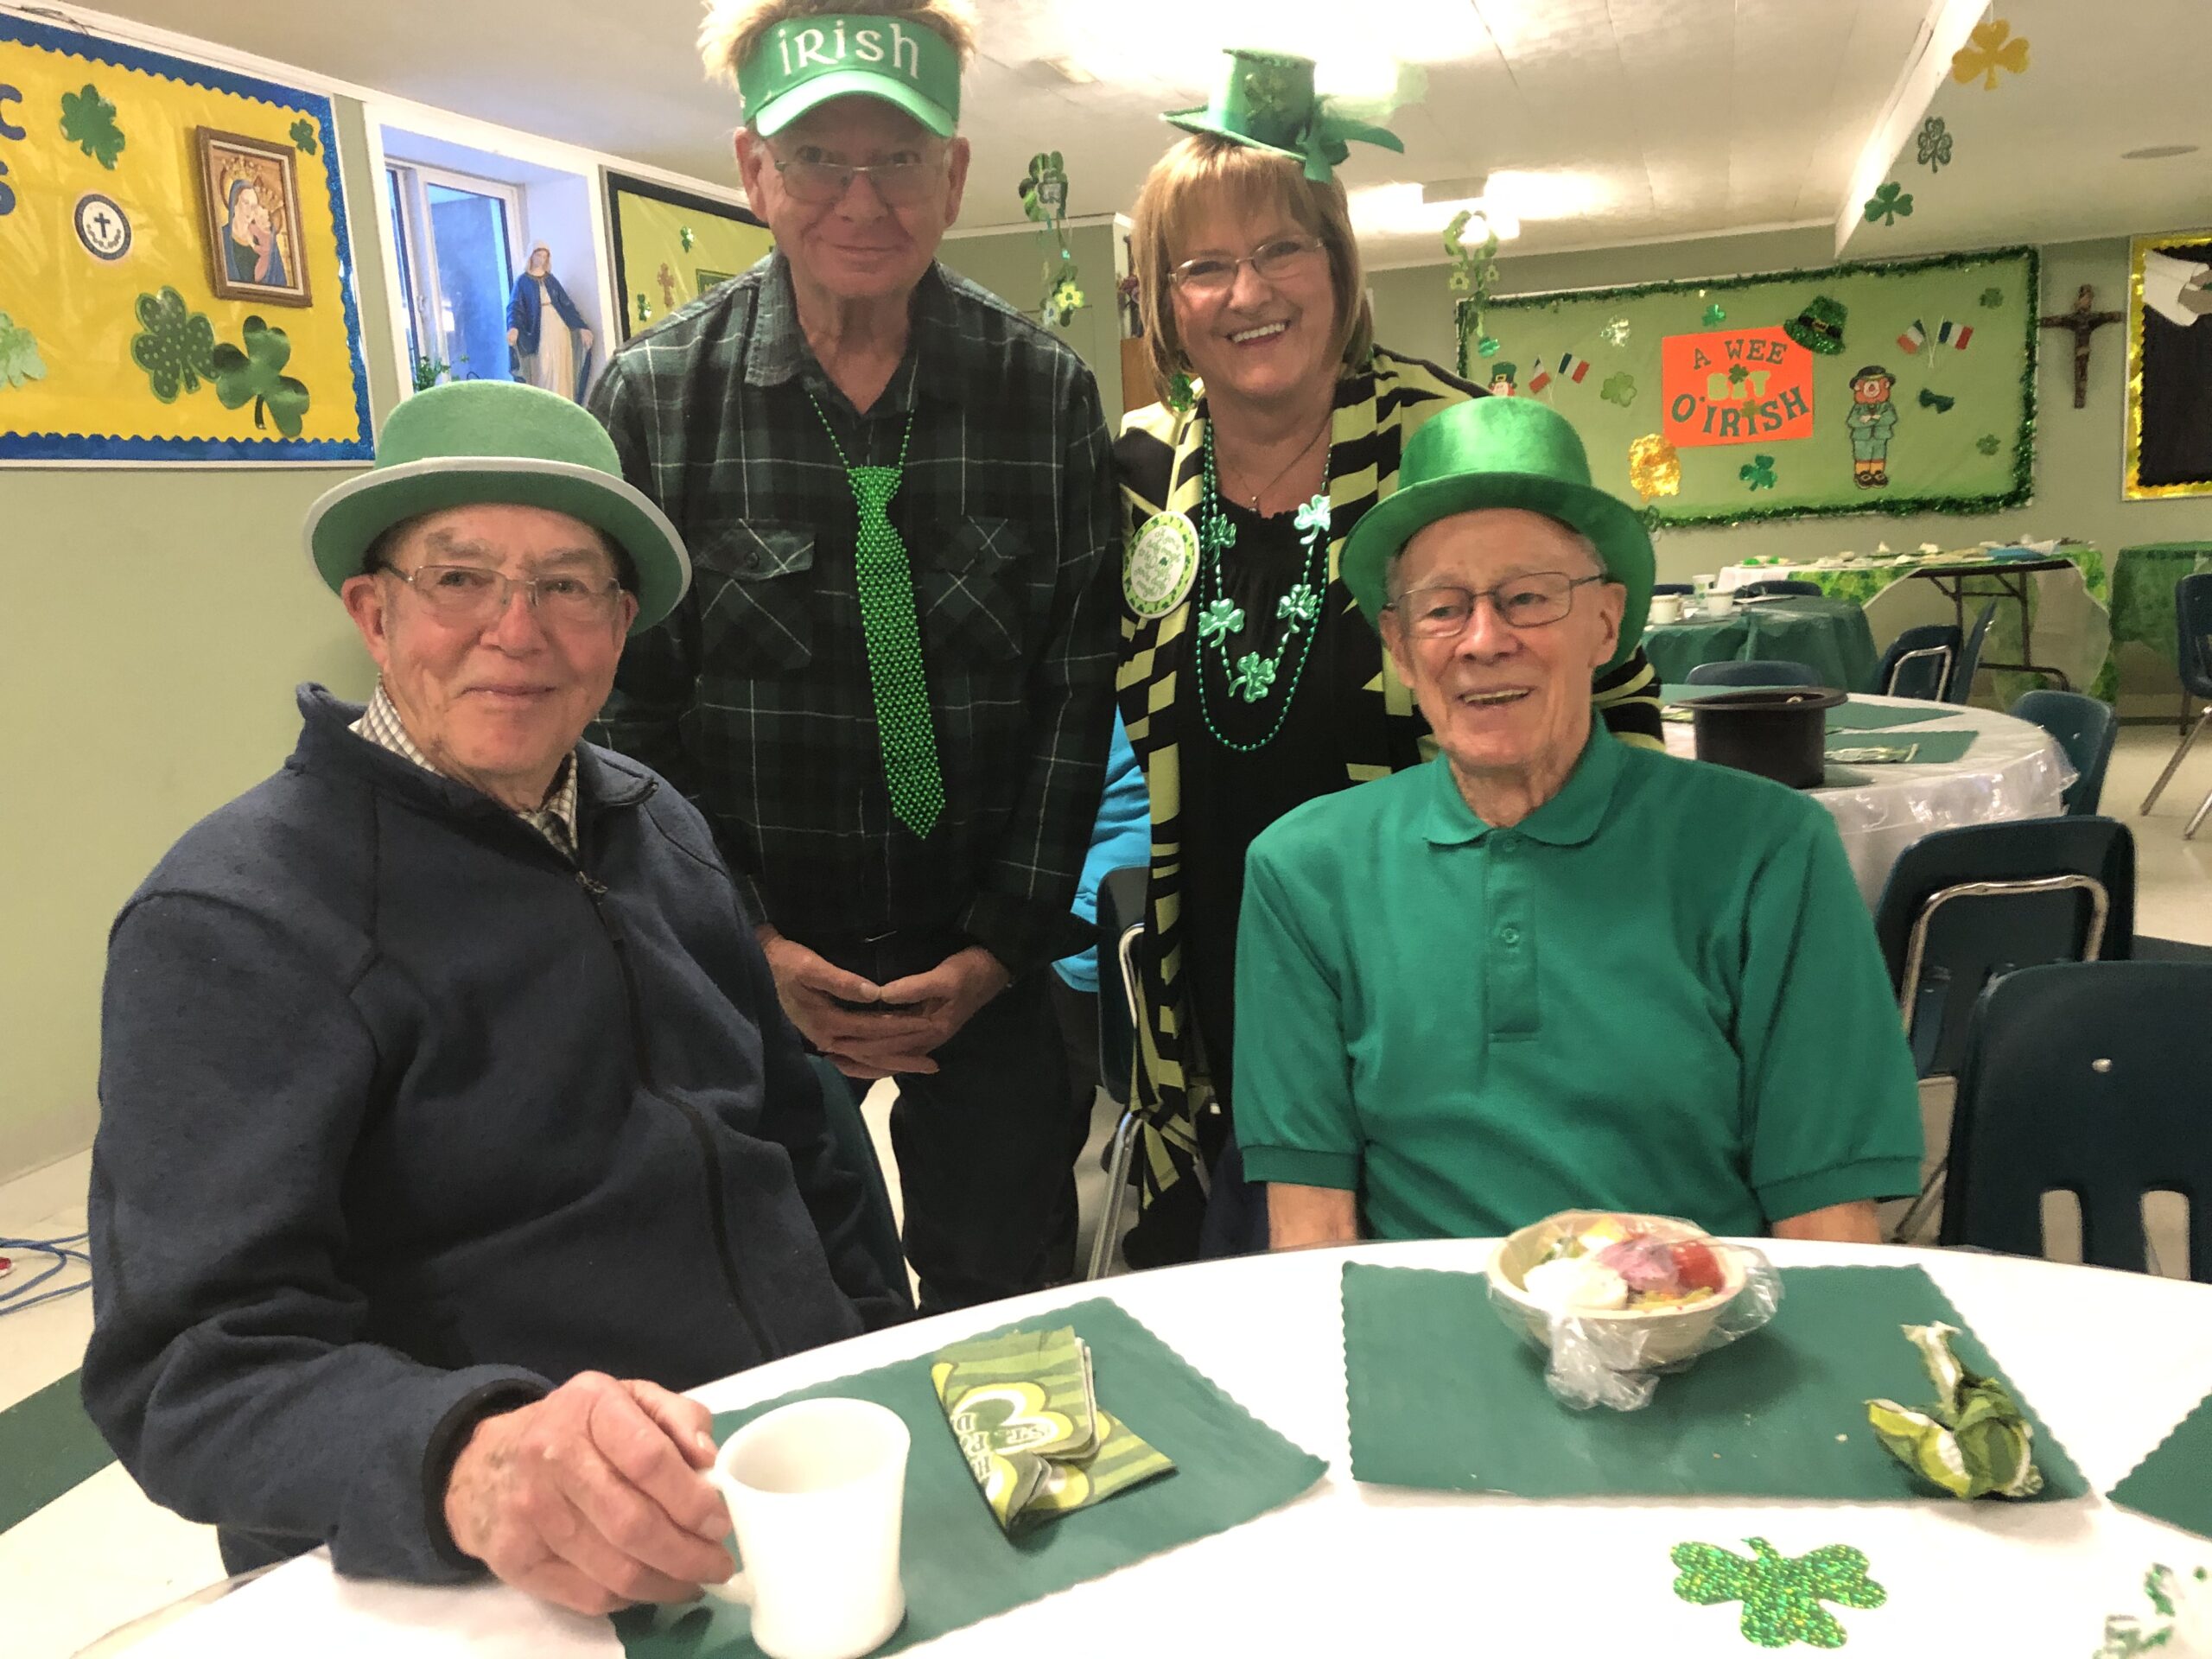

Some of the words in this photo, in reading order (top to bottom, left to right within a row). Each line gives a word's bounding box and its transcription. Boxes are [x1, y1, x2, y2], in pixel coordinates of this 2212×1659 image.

[1694, 347, 1712, 370] A
[1724, 339, 1788, 365] WEE
[1707, 370, 1771, 401] BIT
